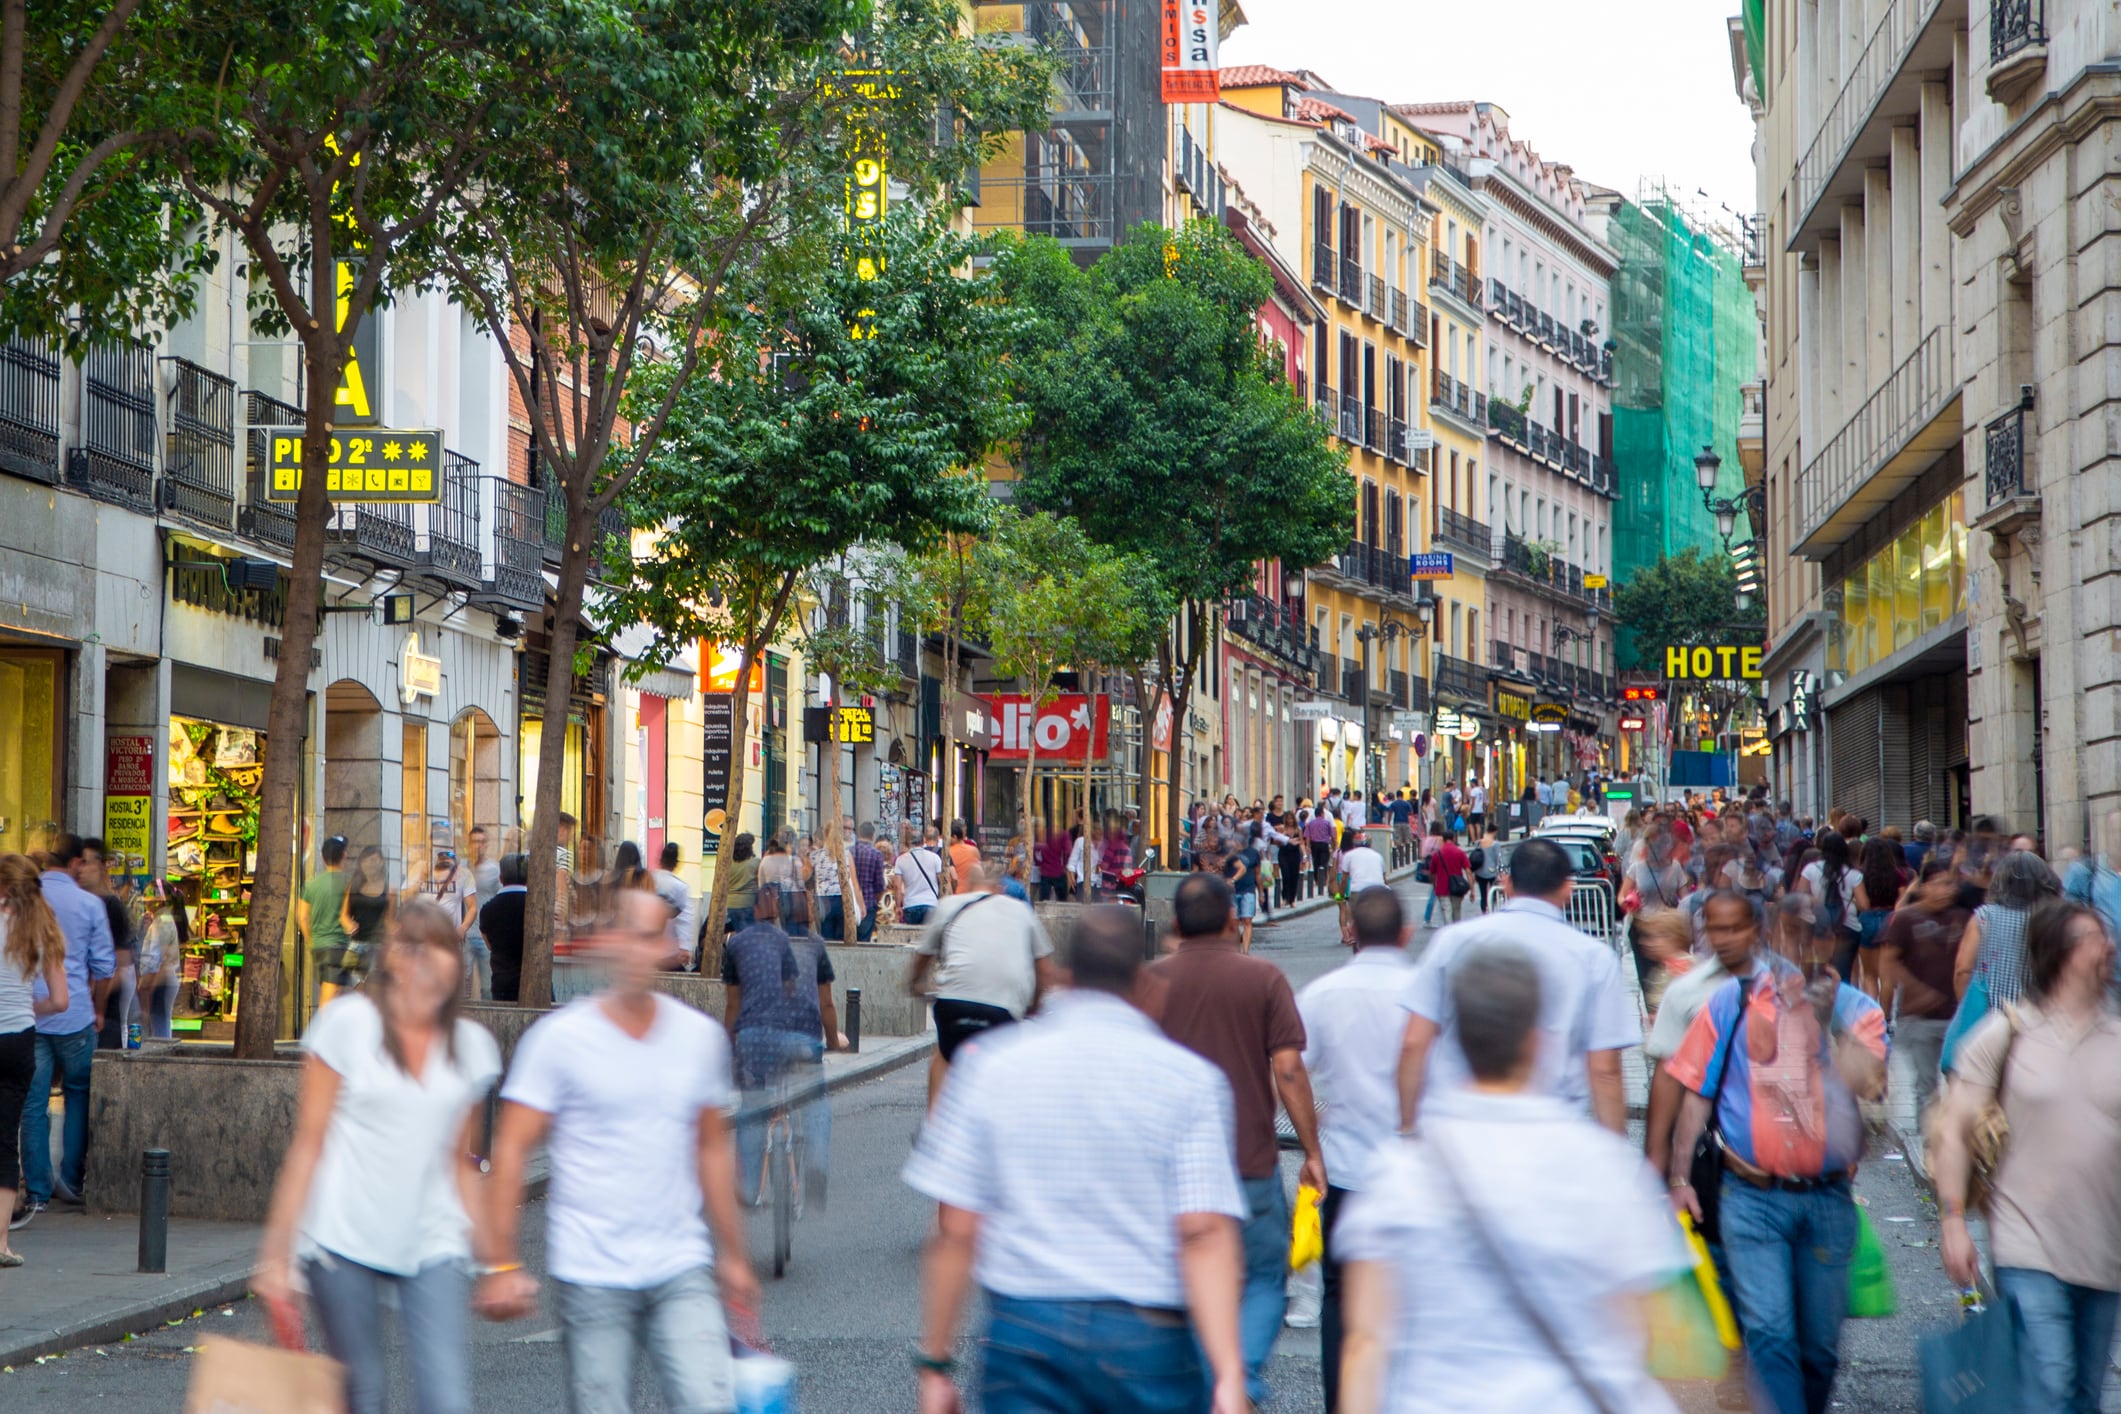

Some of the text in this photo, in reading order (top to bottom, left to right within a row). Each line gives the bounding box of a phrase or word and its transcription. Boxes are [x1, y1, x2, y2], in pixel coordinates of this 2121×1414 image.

[1165, 0, 1177, 62] MIOS
[274, 438, 342, 464] PIO
[1625, 688, 1640, 700] 26
[1792, 671, 1808, 730] ZARA
[839, 708, 867, 716] OSTAL
[110, 738, 140, 746] HOSTAL
[110, 747, 147, 755] VICTORIA
[109, 801, 133, 814] HOSTAL
[109, 818, 146, 830] RESIDENCIA
[112, 838, 143, 849] PRETORIA
